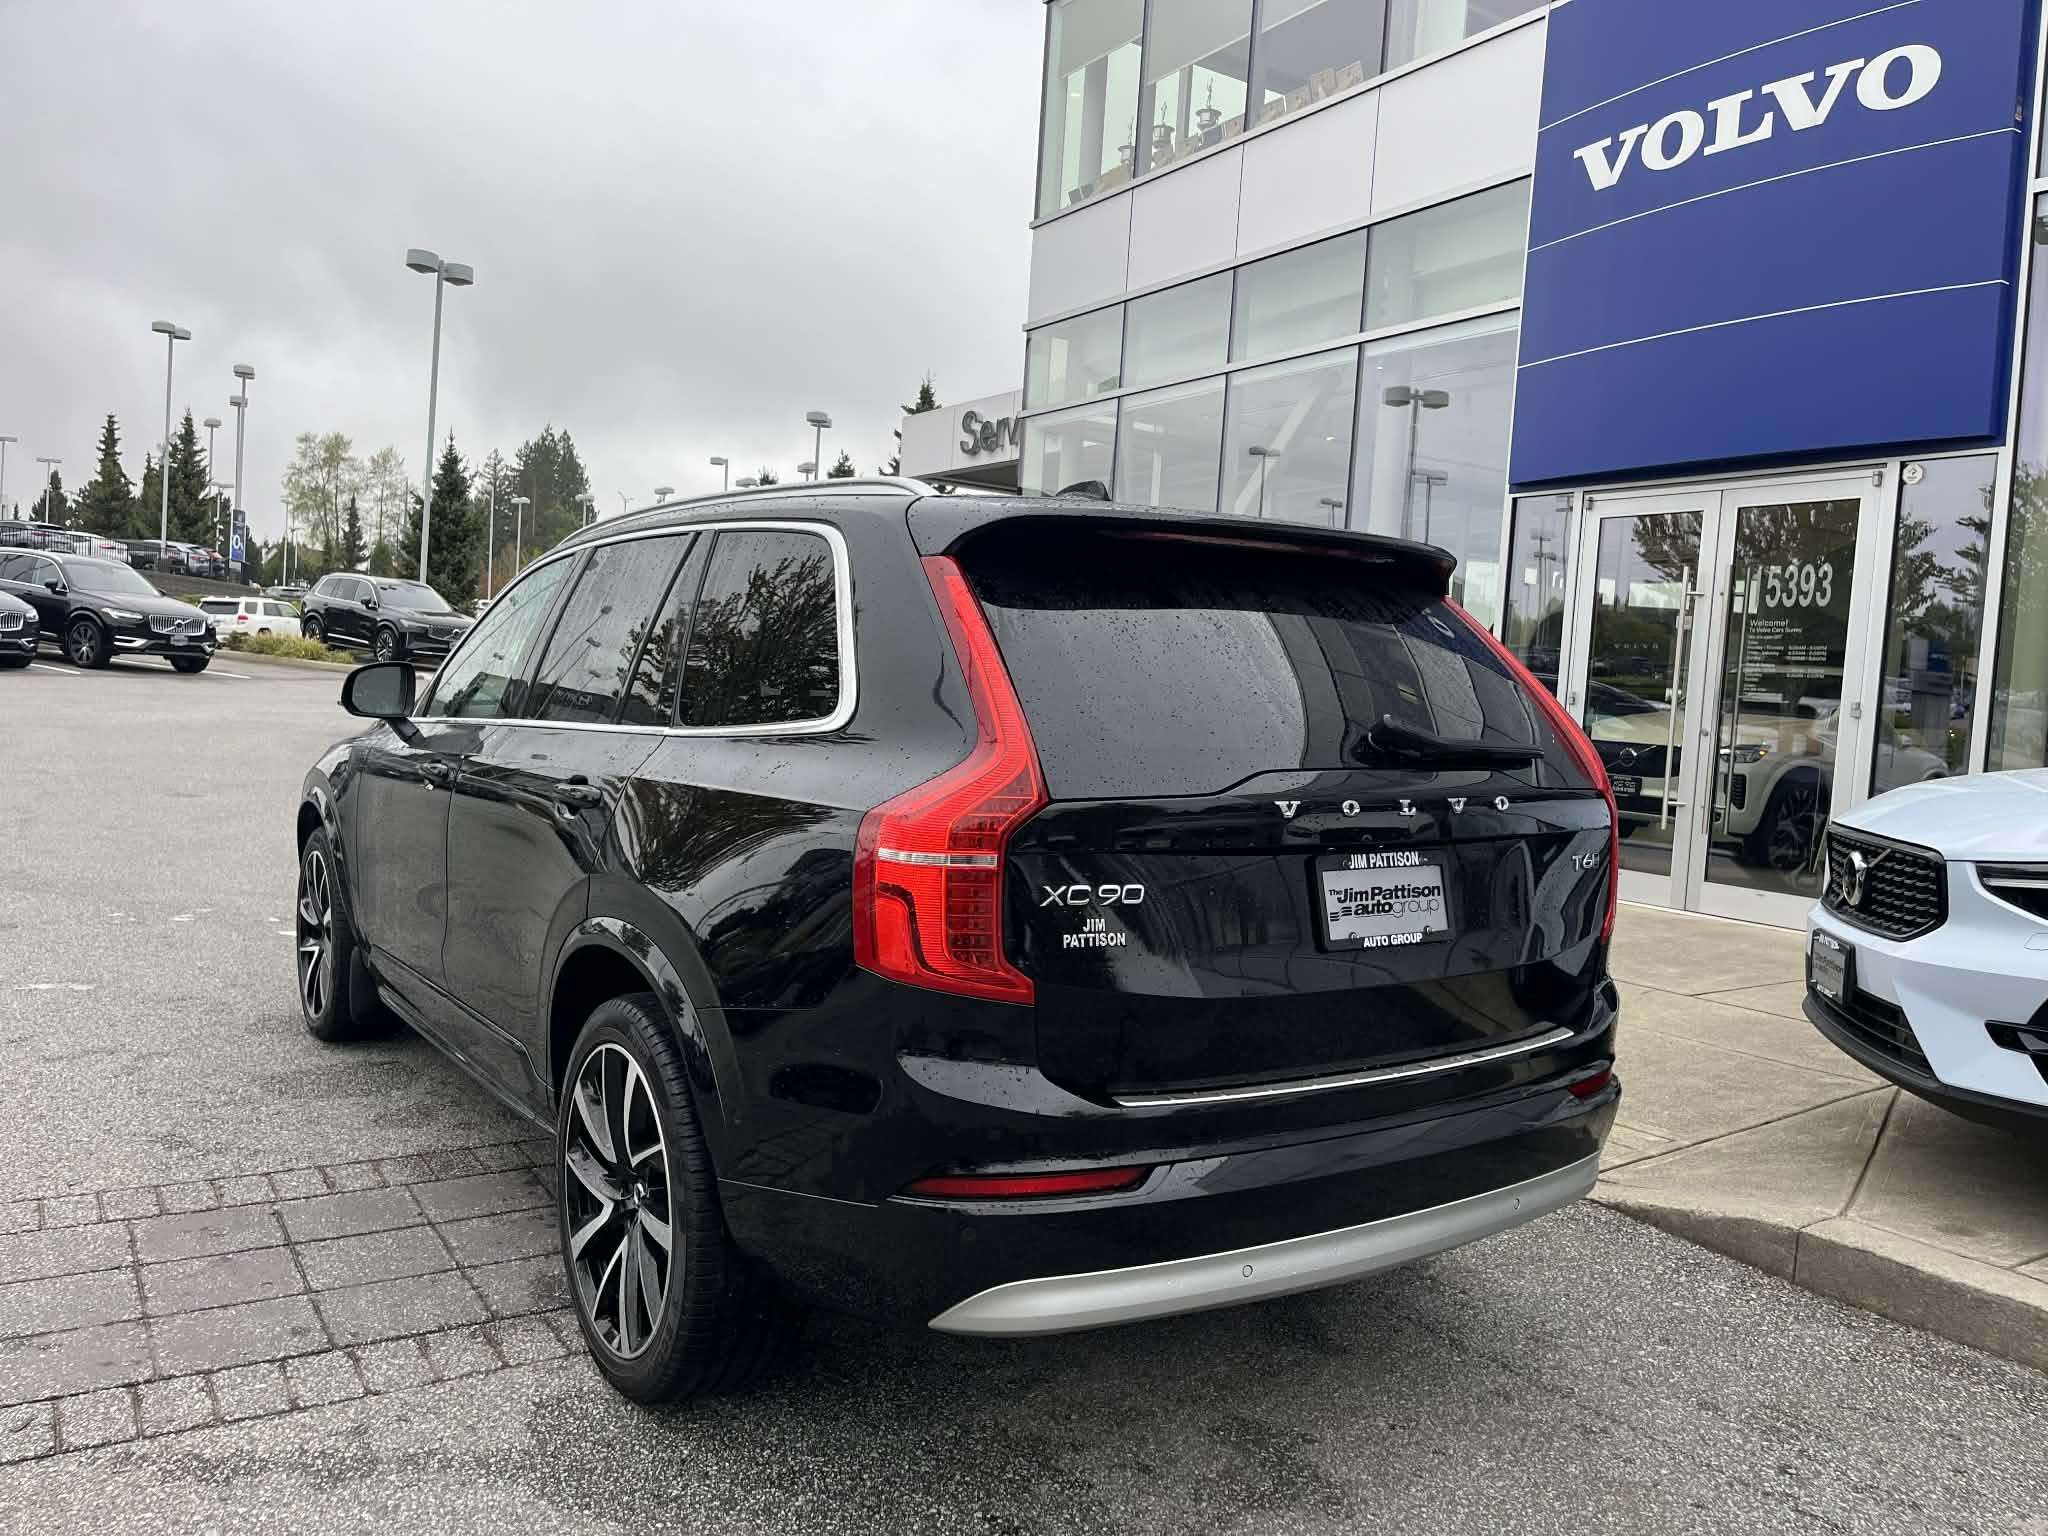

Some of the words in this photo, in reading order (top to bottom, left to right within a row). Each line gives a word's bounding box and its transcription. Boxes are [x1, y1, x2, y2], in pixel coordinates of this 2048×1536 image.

[1573, 44, 1942, 191] VOLVO
[1274, 796, 1509, 819] VOLVO
[1350, 854, 1368, 869] JIM
[1369, 851, 1419, 868] PATTISON
[1083, 918, 1106, 933] JIM
[1063, 932, 1126, 949] PATTISON
[1363, 935, 1388, 948] AUTO
[1390, 932, 1423, 945] GROUP
